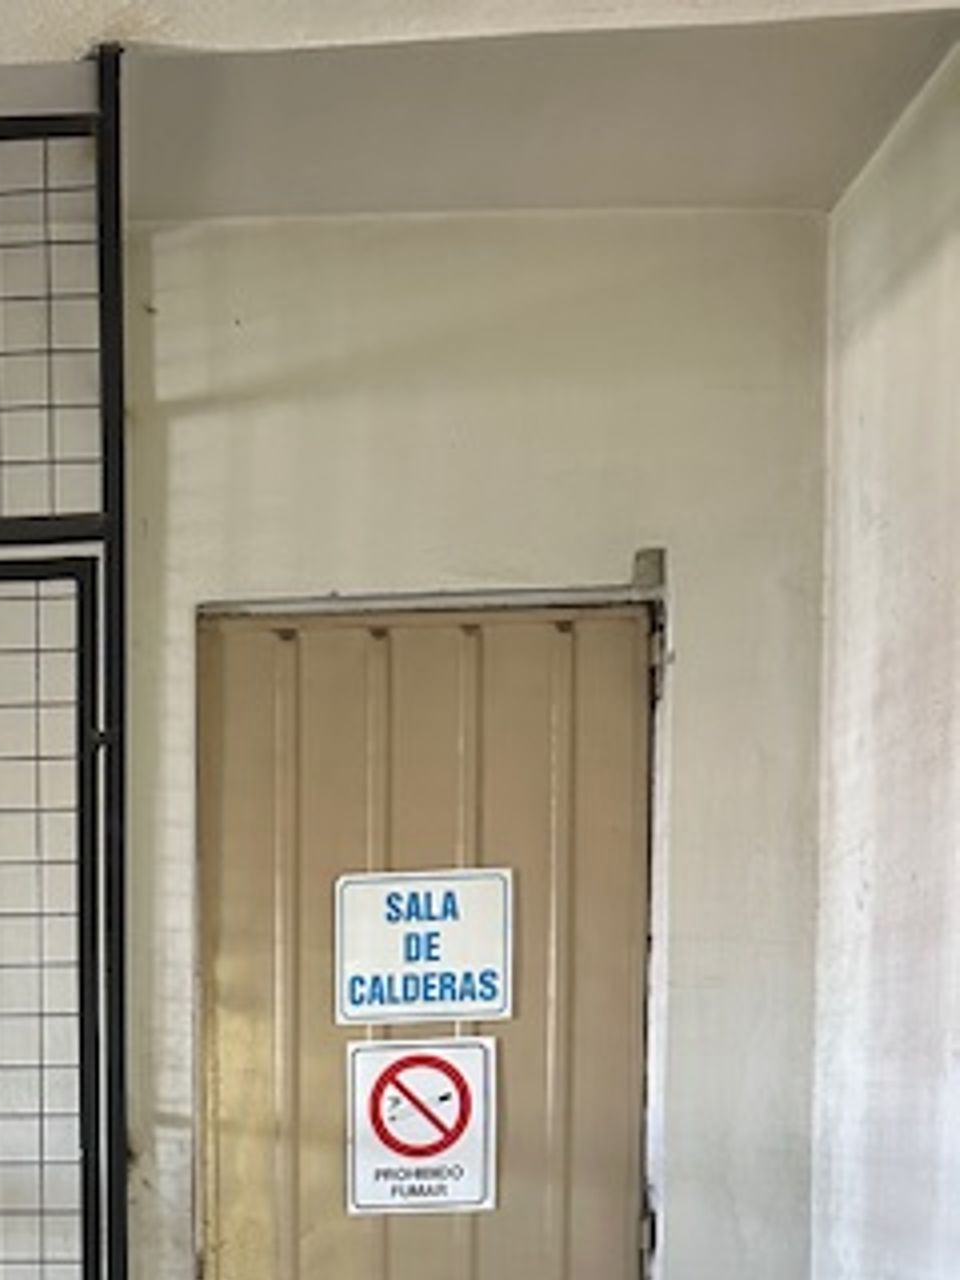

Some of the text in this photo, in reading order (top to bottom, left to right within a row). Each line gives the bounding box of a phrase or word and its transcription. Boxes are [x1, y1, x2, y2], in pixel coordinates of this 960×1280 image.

[386, 891, 459, 922] SALA
[403, 931, 441, 962] DE
[348, 968, 500, 1006] CALDERAS
[374, 1164, 465, 1181] PROHIBIDO
[390, 1183, 449, 1199] FUMAR
